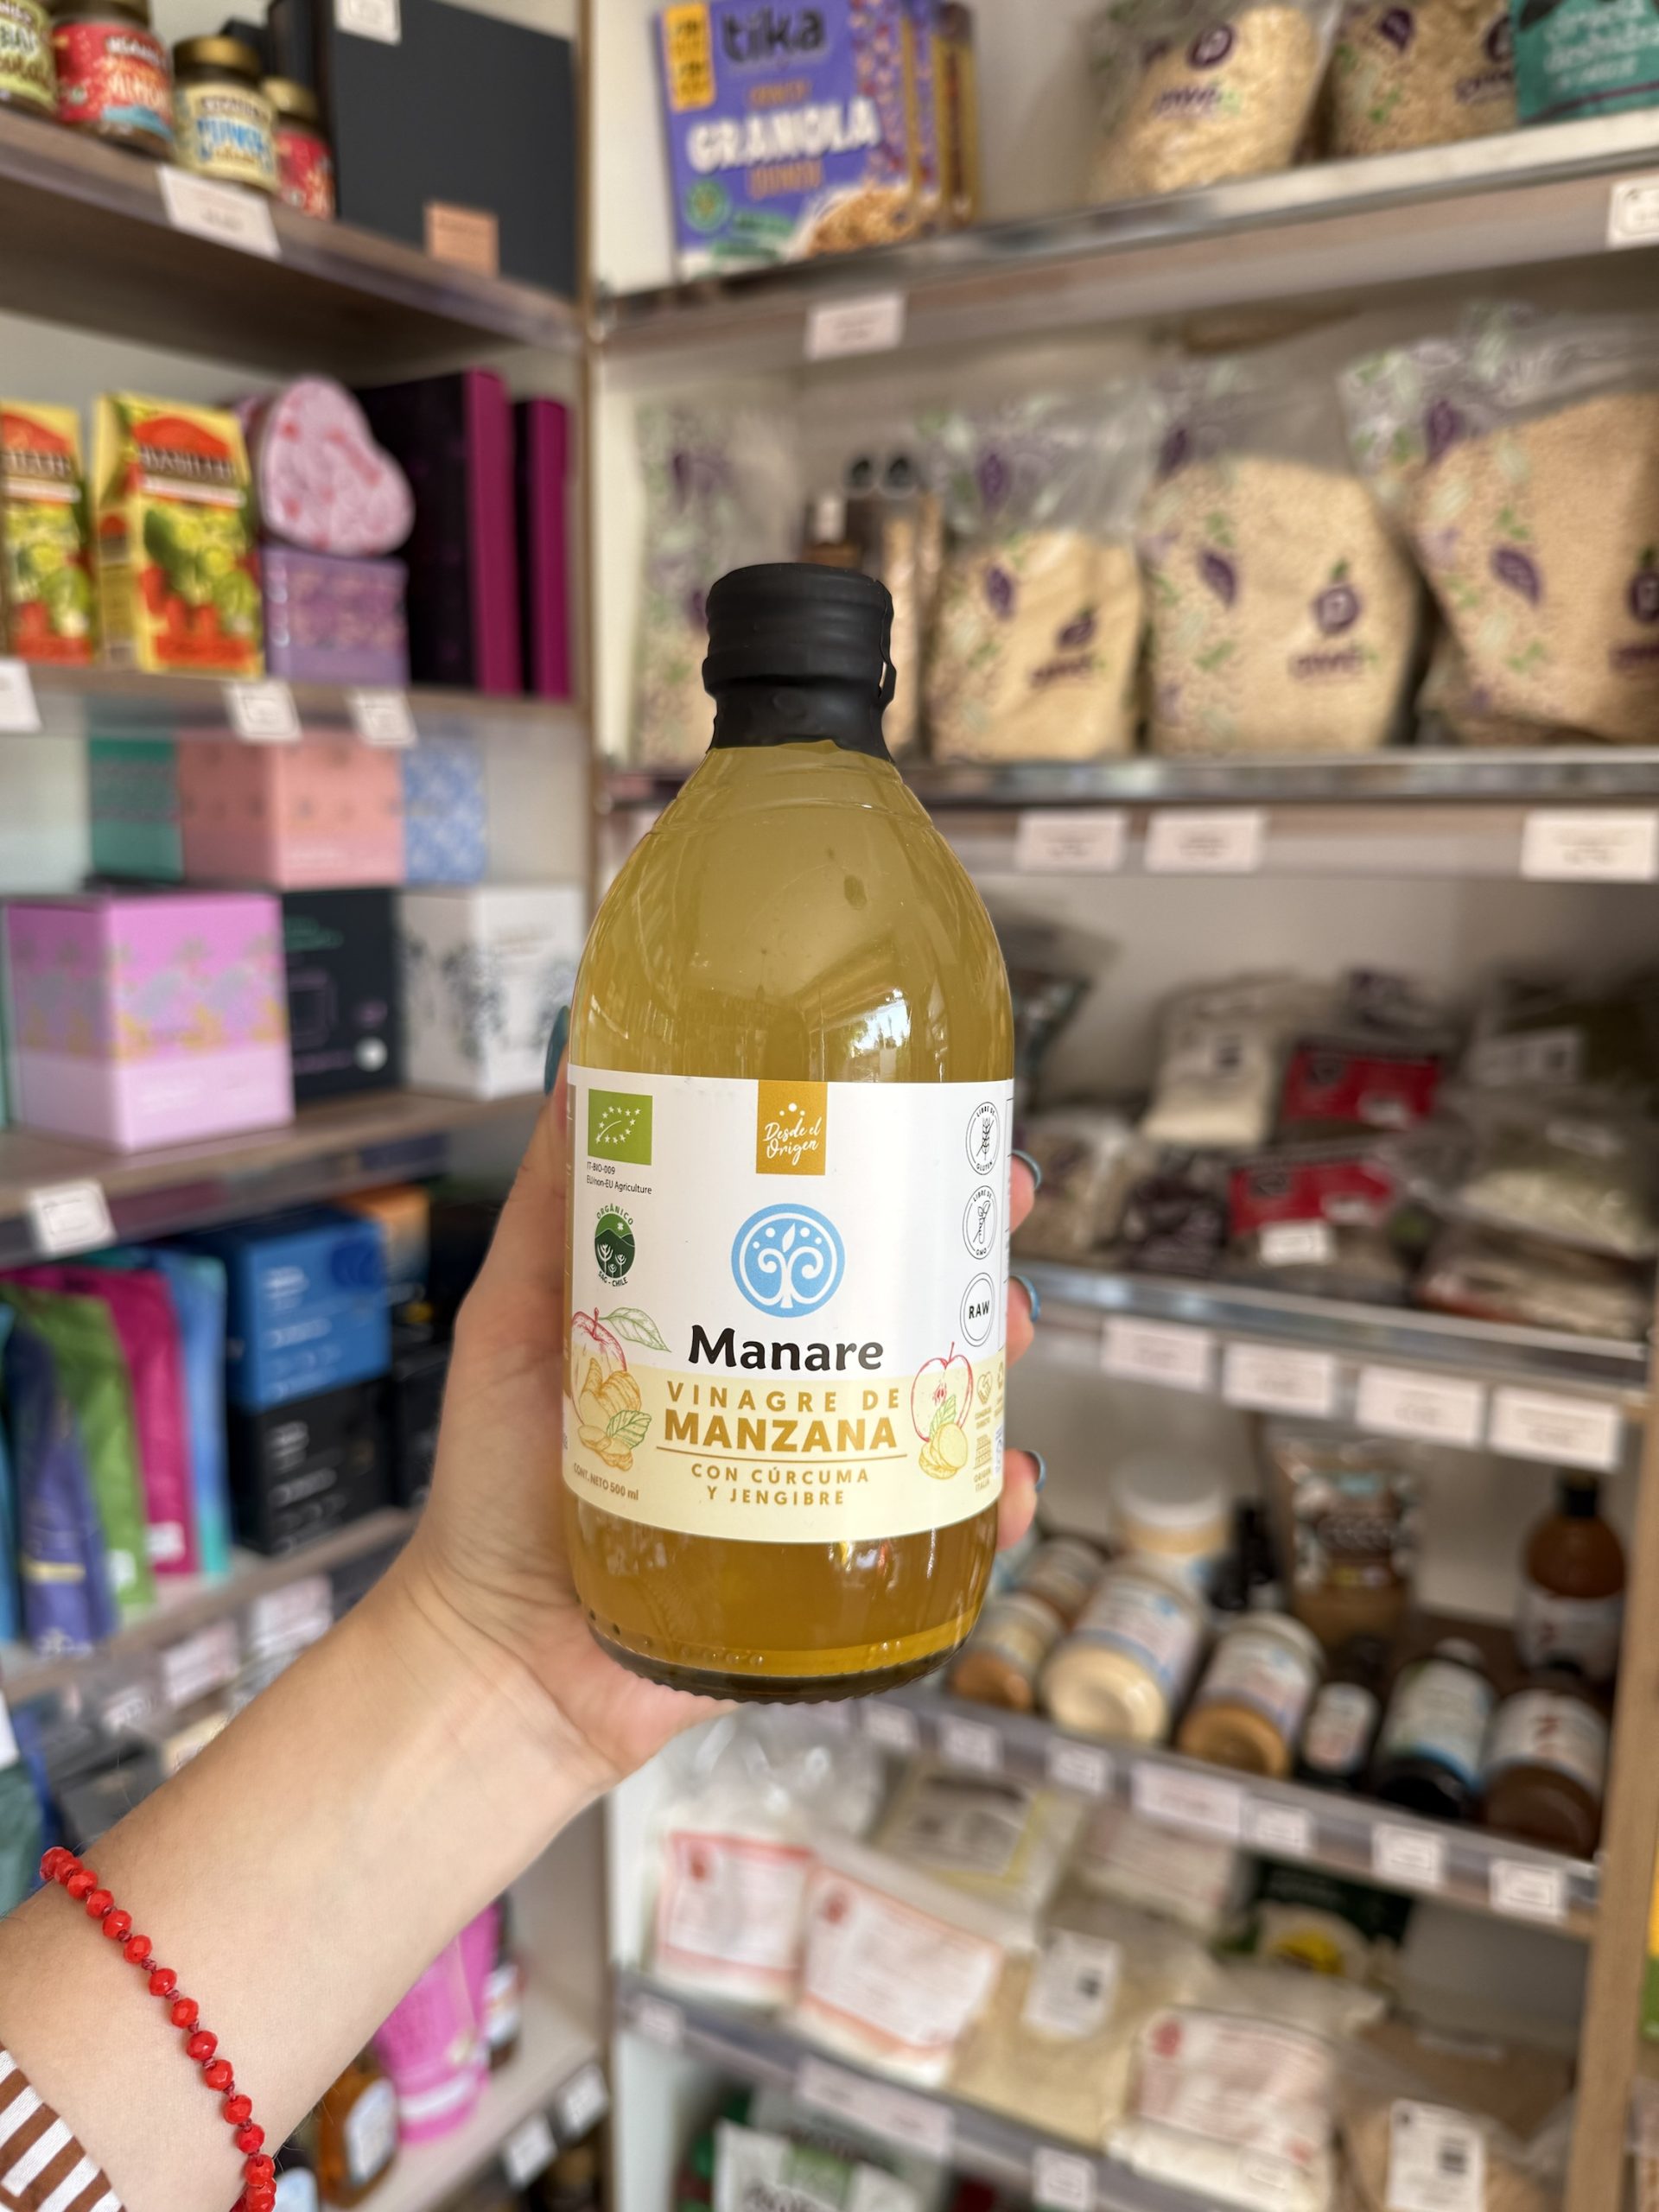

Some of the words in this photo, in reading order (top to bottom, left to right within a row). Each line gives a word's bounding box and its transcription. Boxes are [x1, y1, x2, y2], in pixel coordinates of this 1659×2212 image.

[763, 1117, 807, 1142] Desde
[809, 1116, 822, 1136] el
[766, 1137, 819, 1166] Origen
[587, 1161, 615, 1175] IT-BIO-009
[614, 1180, 652, 1195] Agriculture
[598, 1270, 607, 1284] SAG
[612, 1277, 628, 1287] CHILE
[969, 1300, 989, 1319] RAW
[689, 1325, 883, 1371] Manare
[667, 1381, 836, 1413] VINAGRE
[862, 1388, 899, 1410] DE
[664, 1408, 897, 1452] MANZANA
[574, 1462, 589, 1481] CONT.
[590, 1472, 609, 1491] NETO
[610, 1481, 626, 1497] 500
[627, 1489, 639, 1501] ml
[691, 1463, 738, 1481] CON
[751, 1466, 868, 1484] CÚRCUMA
[707, 1485, 717, 1500] Y
[730, 1488, 843, 1505] JENGIBRE
